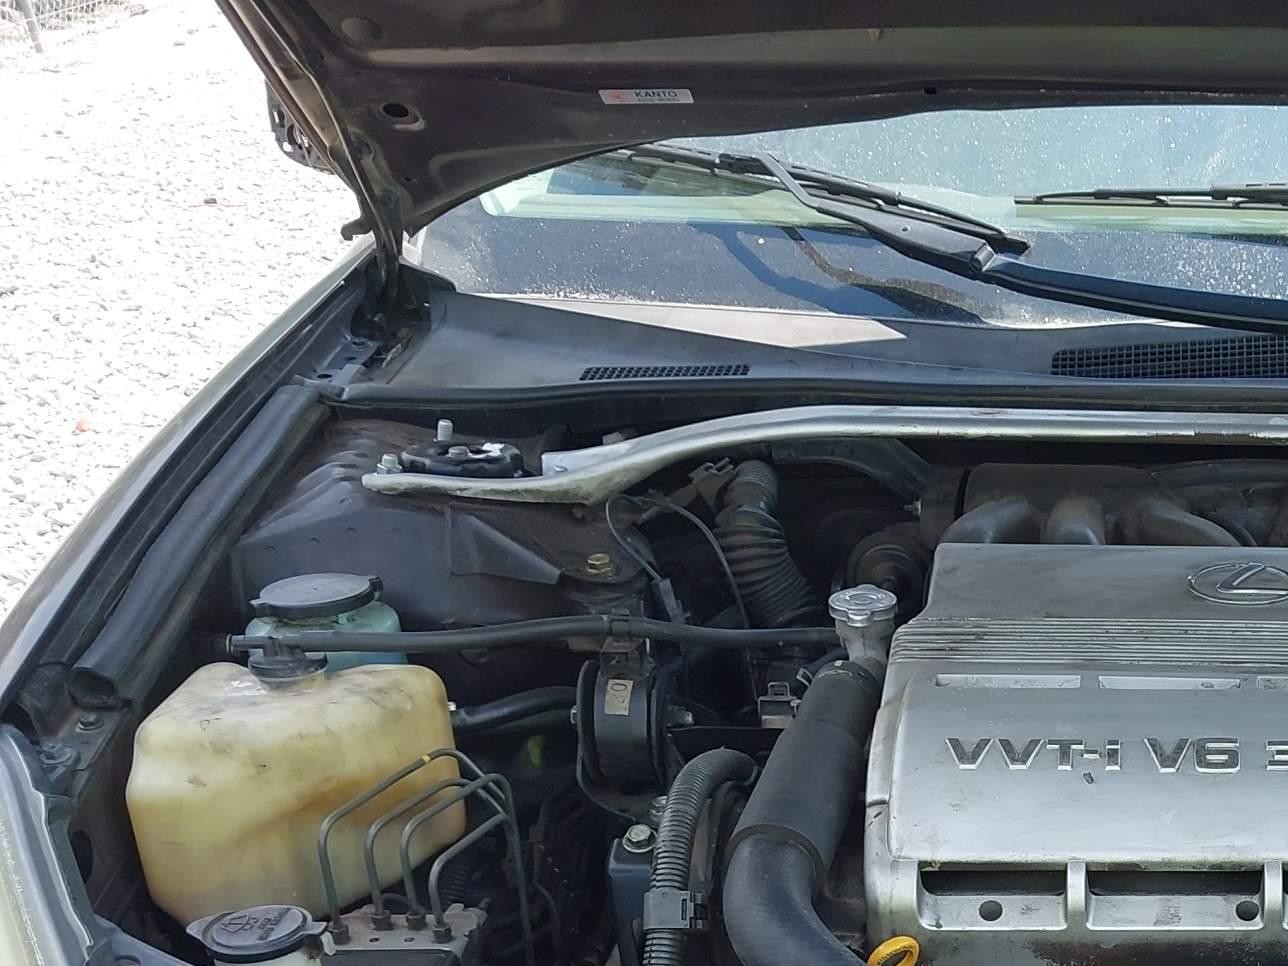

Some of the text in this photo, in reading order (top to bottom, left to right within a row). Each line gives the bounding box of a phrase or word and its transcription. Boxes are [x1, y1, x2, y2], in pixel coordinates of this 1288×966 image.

[633, 90, 678, 98] KANTO
[945, 737, 1122, 771] VVT-i
[1143, 736, 1241, 774] V6
